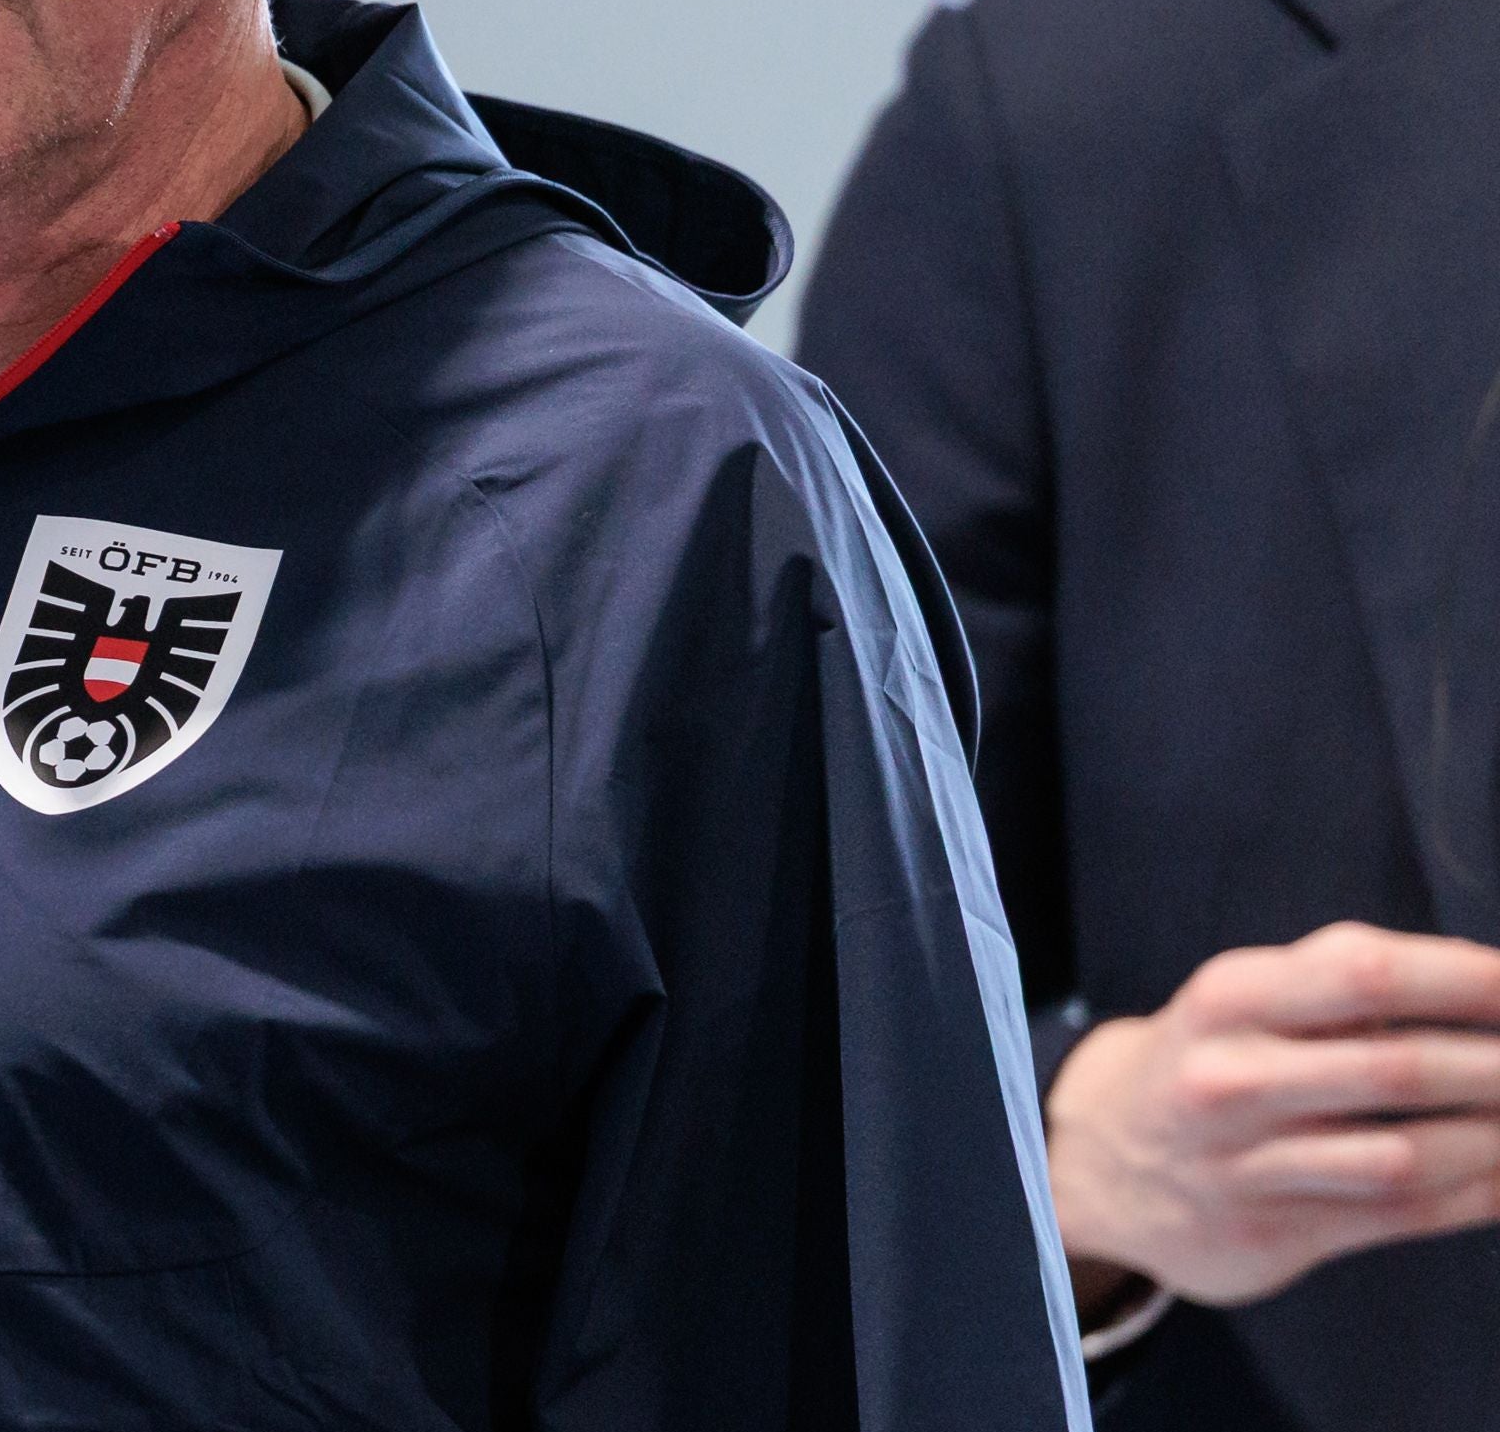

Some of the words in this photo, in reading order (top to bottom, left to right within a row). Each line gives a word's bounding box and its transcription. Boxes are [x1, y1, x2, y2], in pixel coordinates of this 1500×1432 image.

[61, 546, 92, 558] SEIT
[99, 541, 202, 584] ÖFB
[208, 571, 237, 583] 1904
